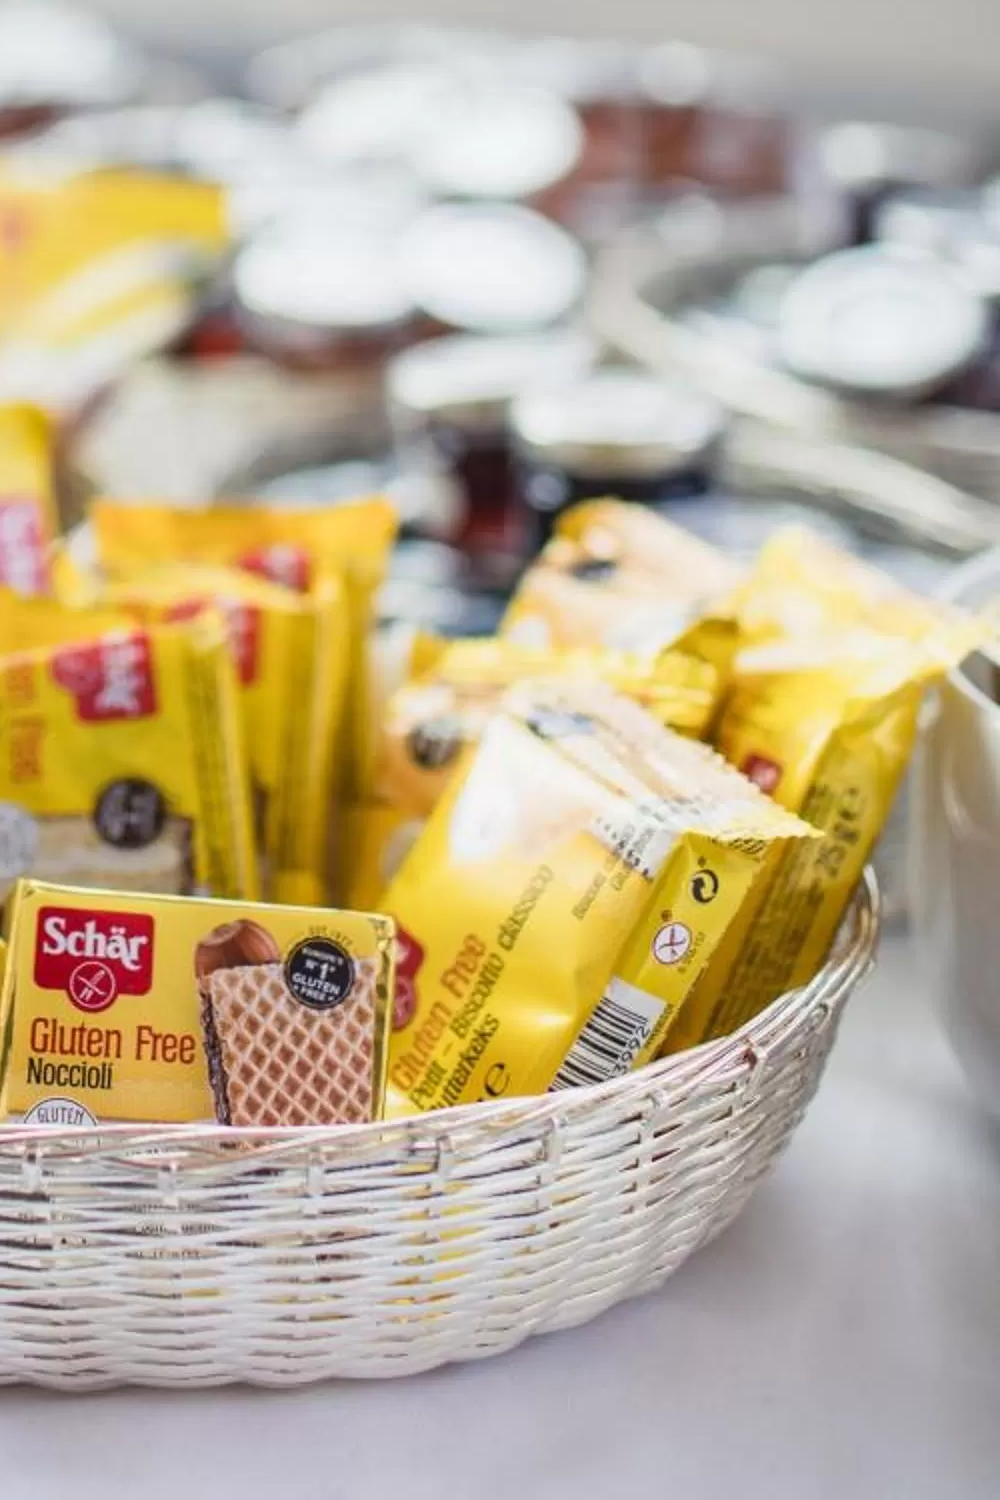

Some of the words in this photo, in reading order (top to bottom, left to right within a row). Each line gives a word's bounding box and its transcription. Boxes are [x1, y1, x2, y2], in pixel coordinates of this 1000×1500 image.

[496, 864, 554, 952] classico
[42, 916, 149, 972] Schär
[291, 971, 342, 996] GLUTEN
[389, 1001, 451, 1093] Gluten
[440, 933, 487, 998] Free
[29, 1016, 122, 1060] Gluten
[134, 1024, 197, 1066] Free
[430, 1013, 499, 1110] utterkeks
[26, 1056, 114, 1091] Noccioli
[37, 1107, 85, 1125] GLUTEN
